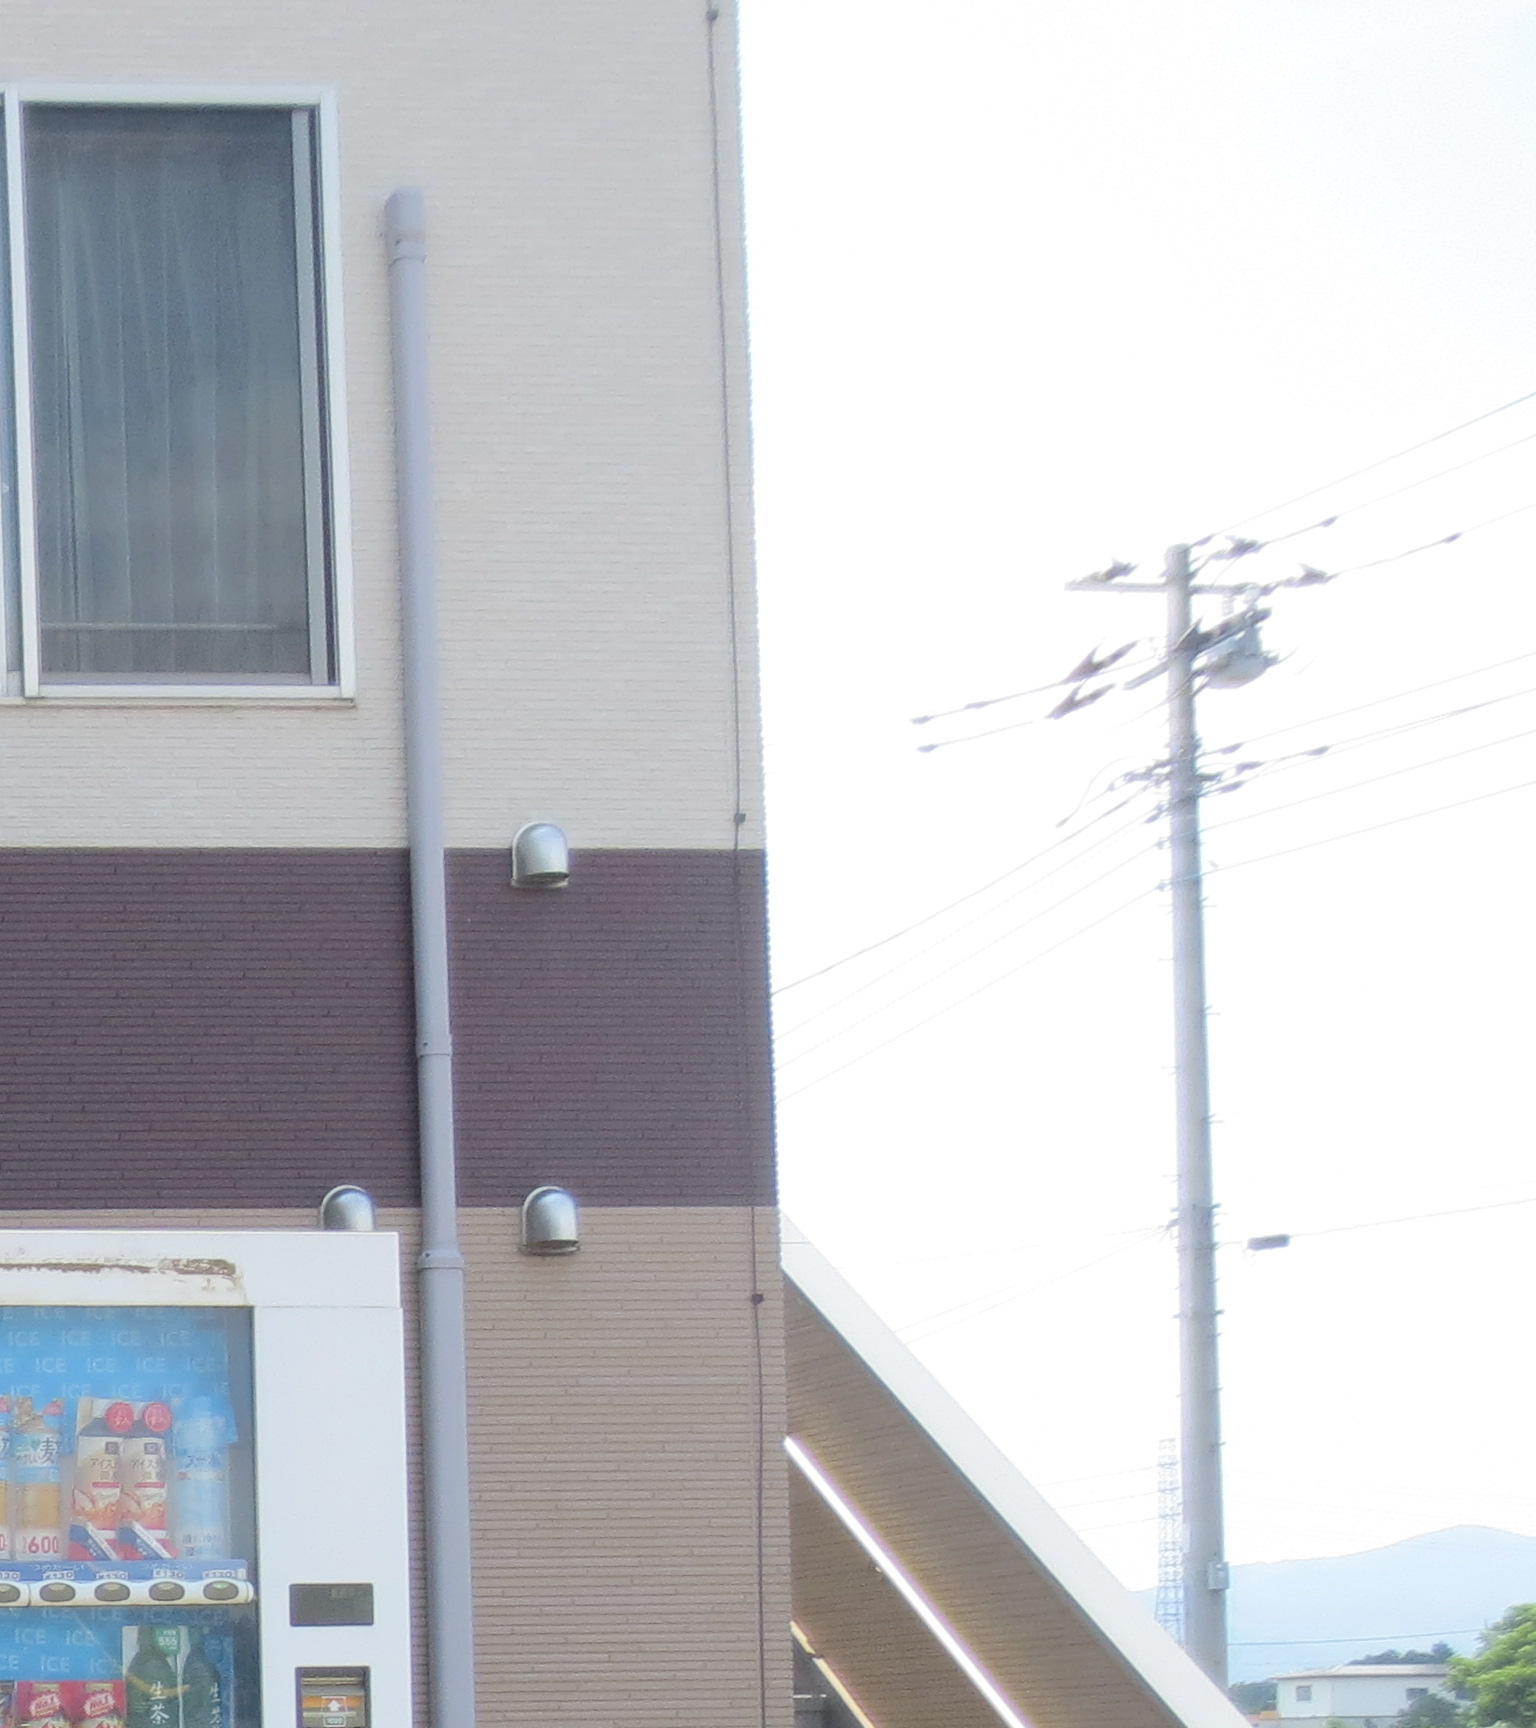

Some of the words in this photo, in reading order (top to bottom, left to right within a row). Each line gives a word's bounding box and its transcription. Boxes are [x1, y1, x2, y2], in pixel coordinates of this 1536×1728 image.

[8, 1331, 40, 1346] ICE
[61, 1331, 91, 1346] ICE
[113, 1331, 141, 1346] ICE
[36, 1358, 68, 1374] ICE
[87, 1357, 116, 1373] ICE
[136, 1357, 167, 1373] ICE
[61, 1384, 92, 1399] ICE
[112, 1384, 142, 1398] ICE
[29, 1535, 60, 1554] 600
[15, 1628, 46, 1645] ICE
[41, 1657, 71, 1673] ICE
[149, 1681, 171, 1725] 生茶
